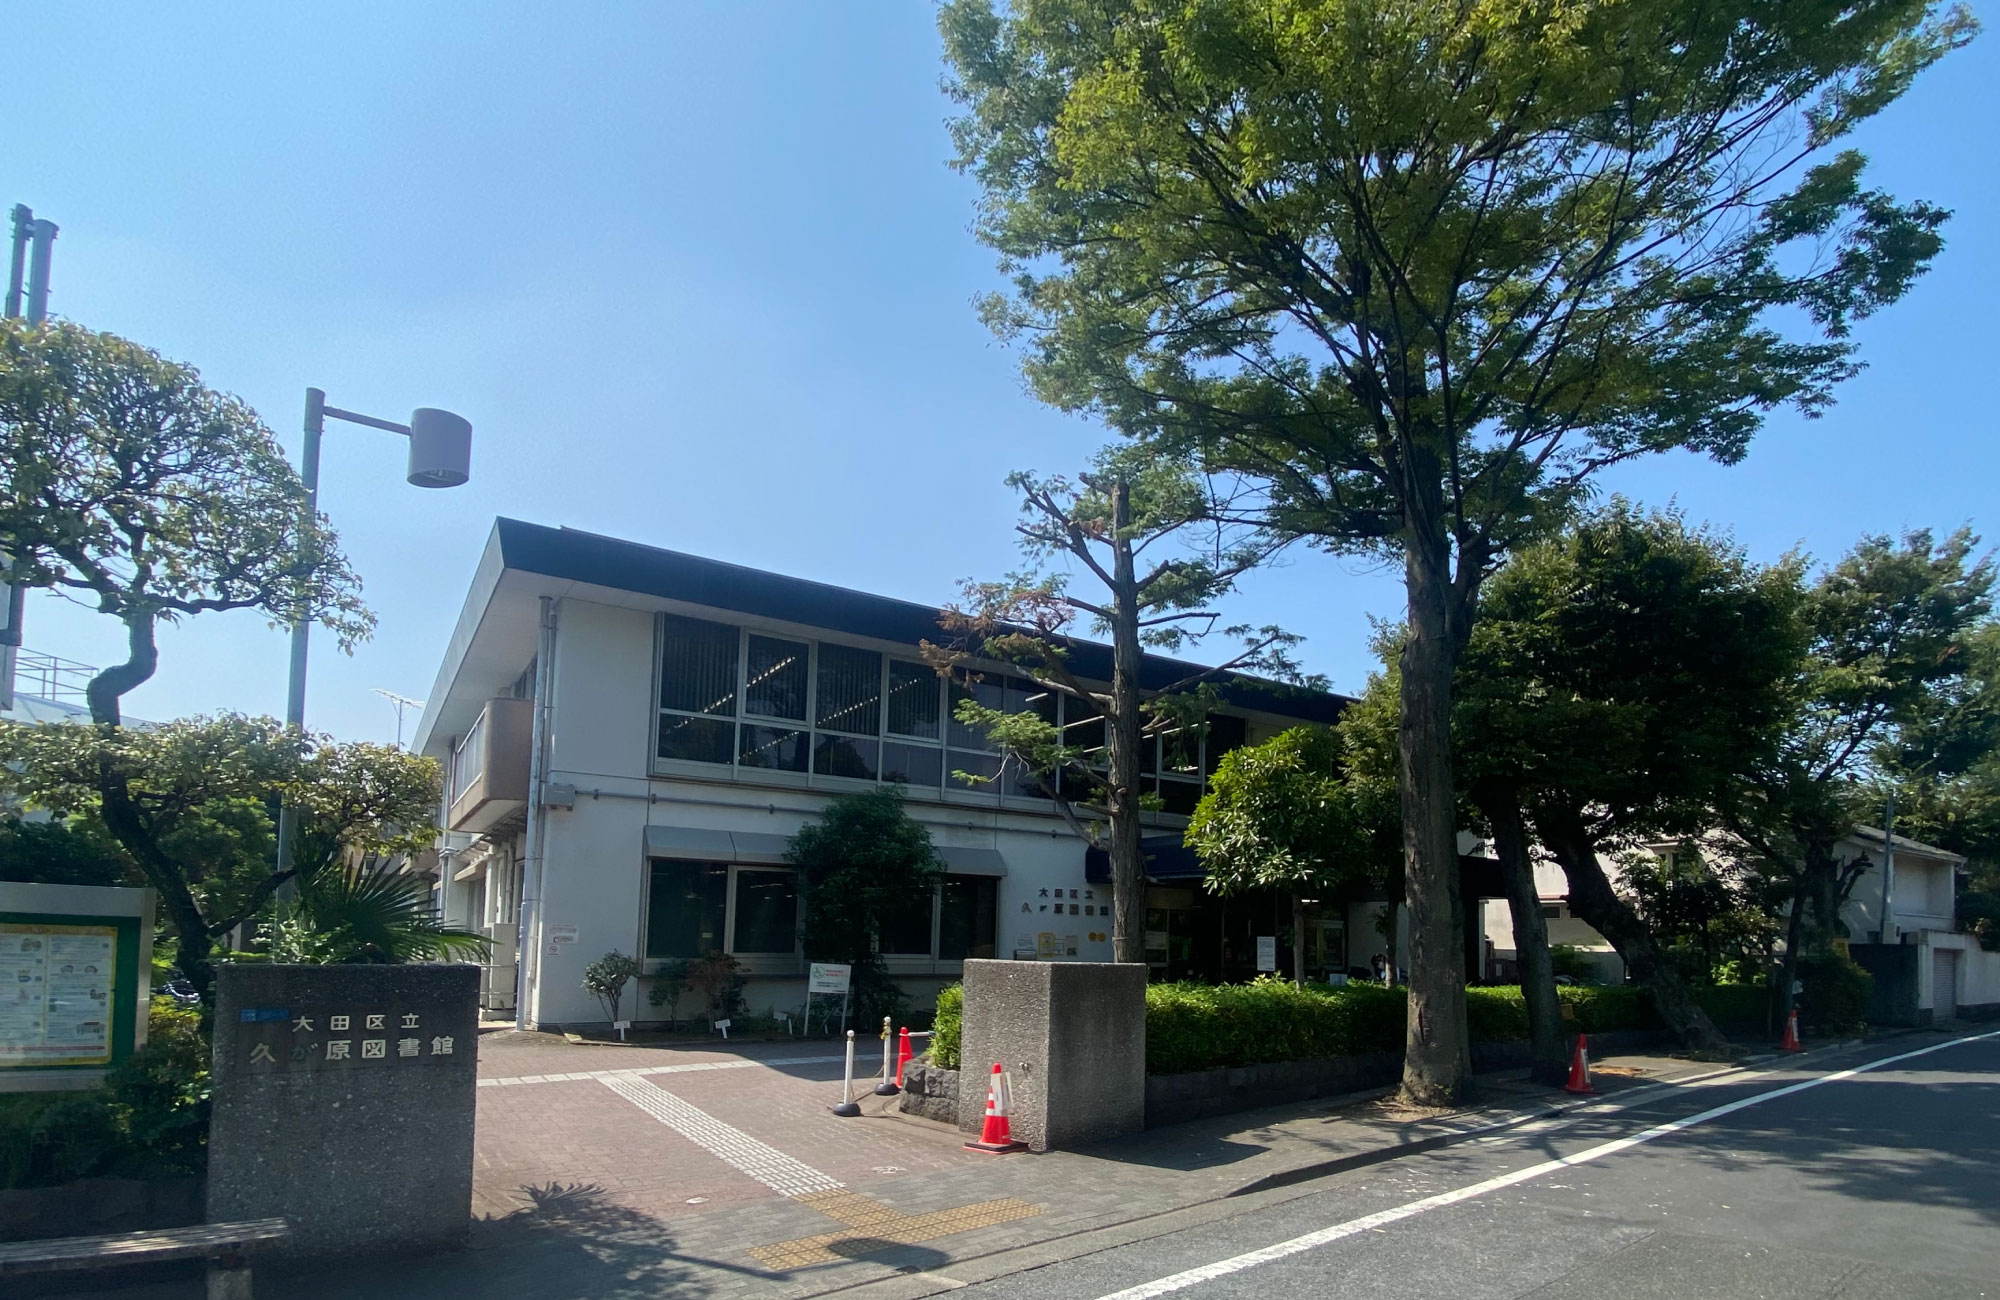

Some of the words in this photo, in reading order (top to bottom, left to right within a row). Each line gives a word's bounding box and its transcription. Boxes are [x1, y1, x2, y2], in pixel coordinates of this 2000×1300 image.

[292, 1012, 420, 1032] 大田区立
[249, 1036, 455, 1064] 久が原図書館
